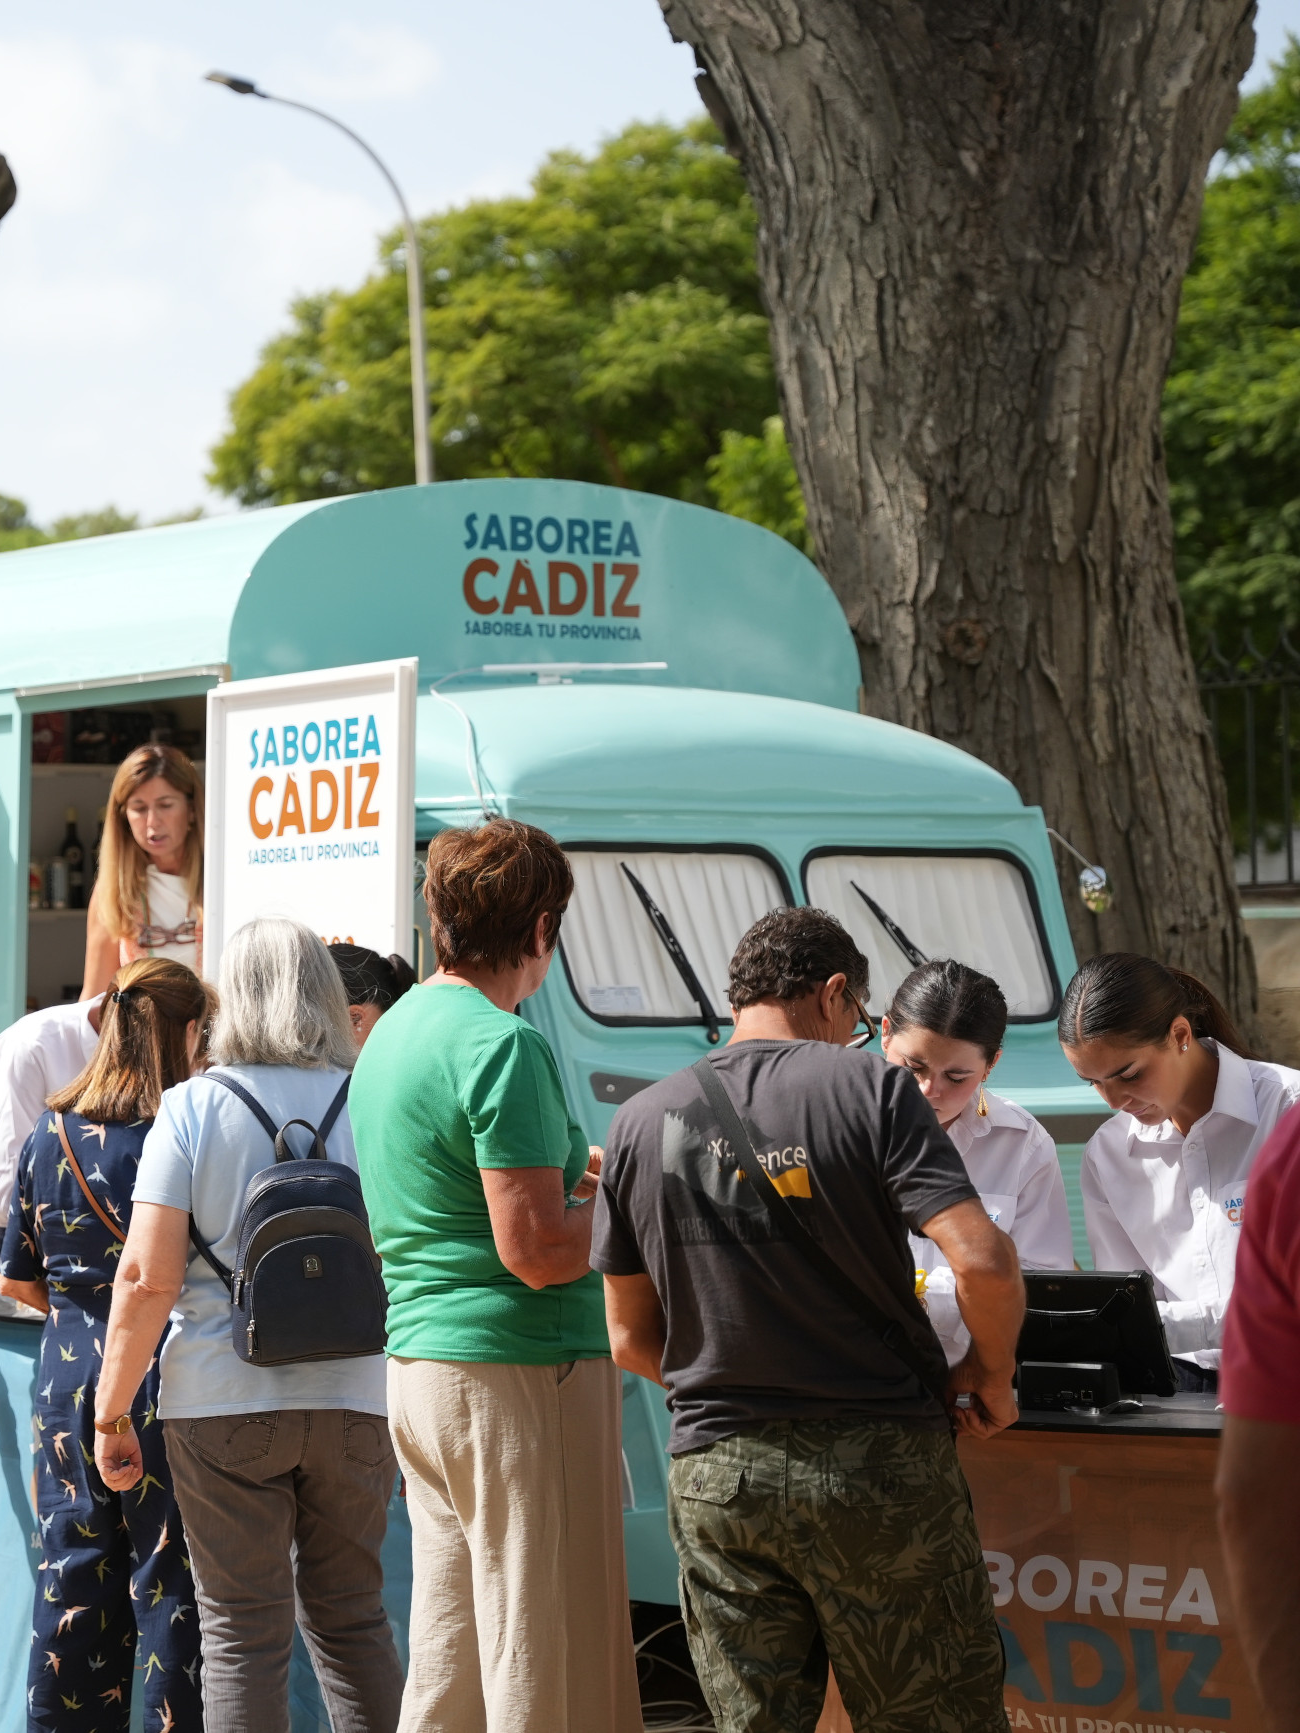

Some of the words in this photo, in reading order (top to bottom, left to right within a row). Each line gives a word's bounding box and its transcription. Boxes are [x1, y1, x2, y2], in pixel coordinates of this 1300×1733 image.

[463, 512, 641, 557] SABOREA
[464, 621, 533, 637] SABOREA
[536, 623, 555, 638] TU
[560, 624, 642, 641] PROVINCIA
[249, 715, 381, 769] SABOREA
[248, 847, 297, 865] SABOREA
[300, 845, 314, 861] TU
[317, 841, 380, 860] PROVINCIA
[982, 1551, 1220, 1626] BOREA
